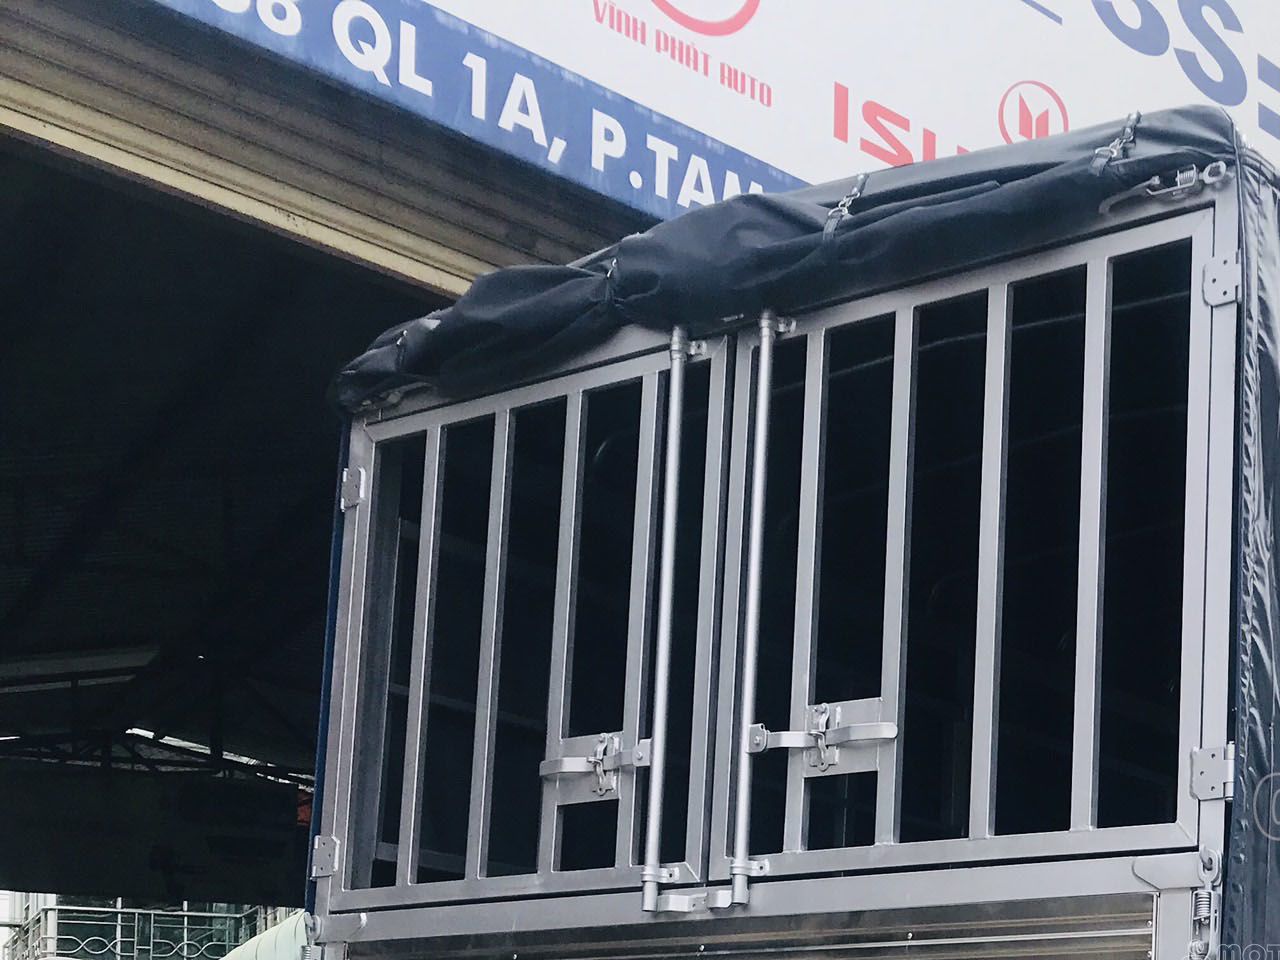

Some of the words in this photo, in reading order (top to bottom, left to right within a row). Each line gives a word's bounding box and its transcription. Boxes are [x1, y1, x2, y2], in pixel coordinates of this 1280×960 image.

[332, 0, 433, 97] QL
[462, 52, 567, 164] 1A,
[720, 62, 772, 108] AUTO
